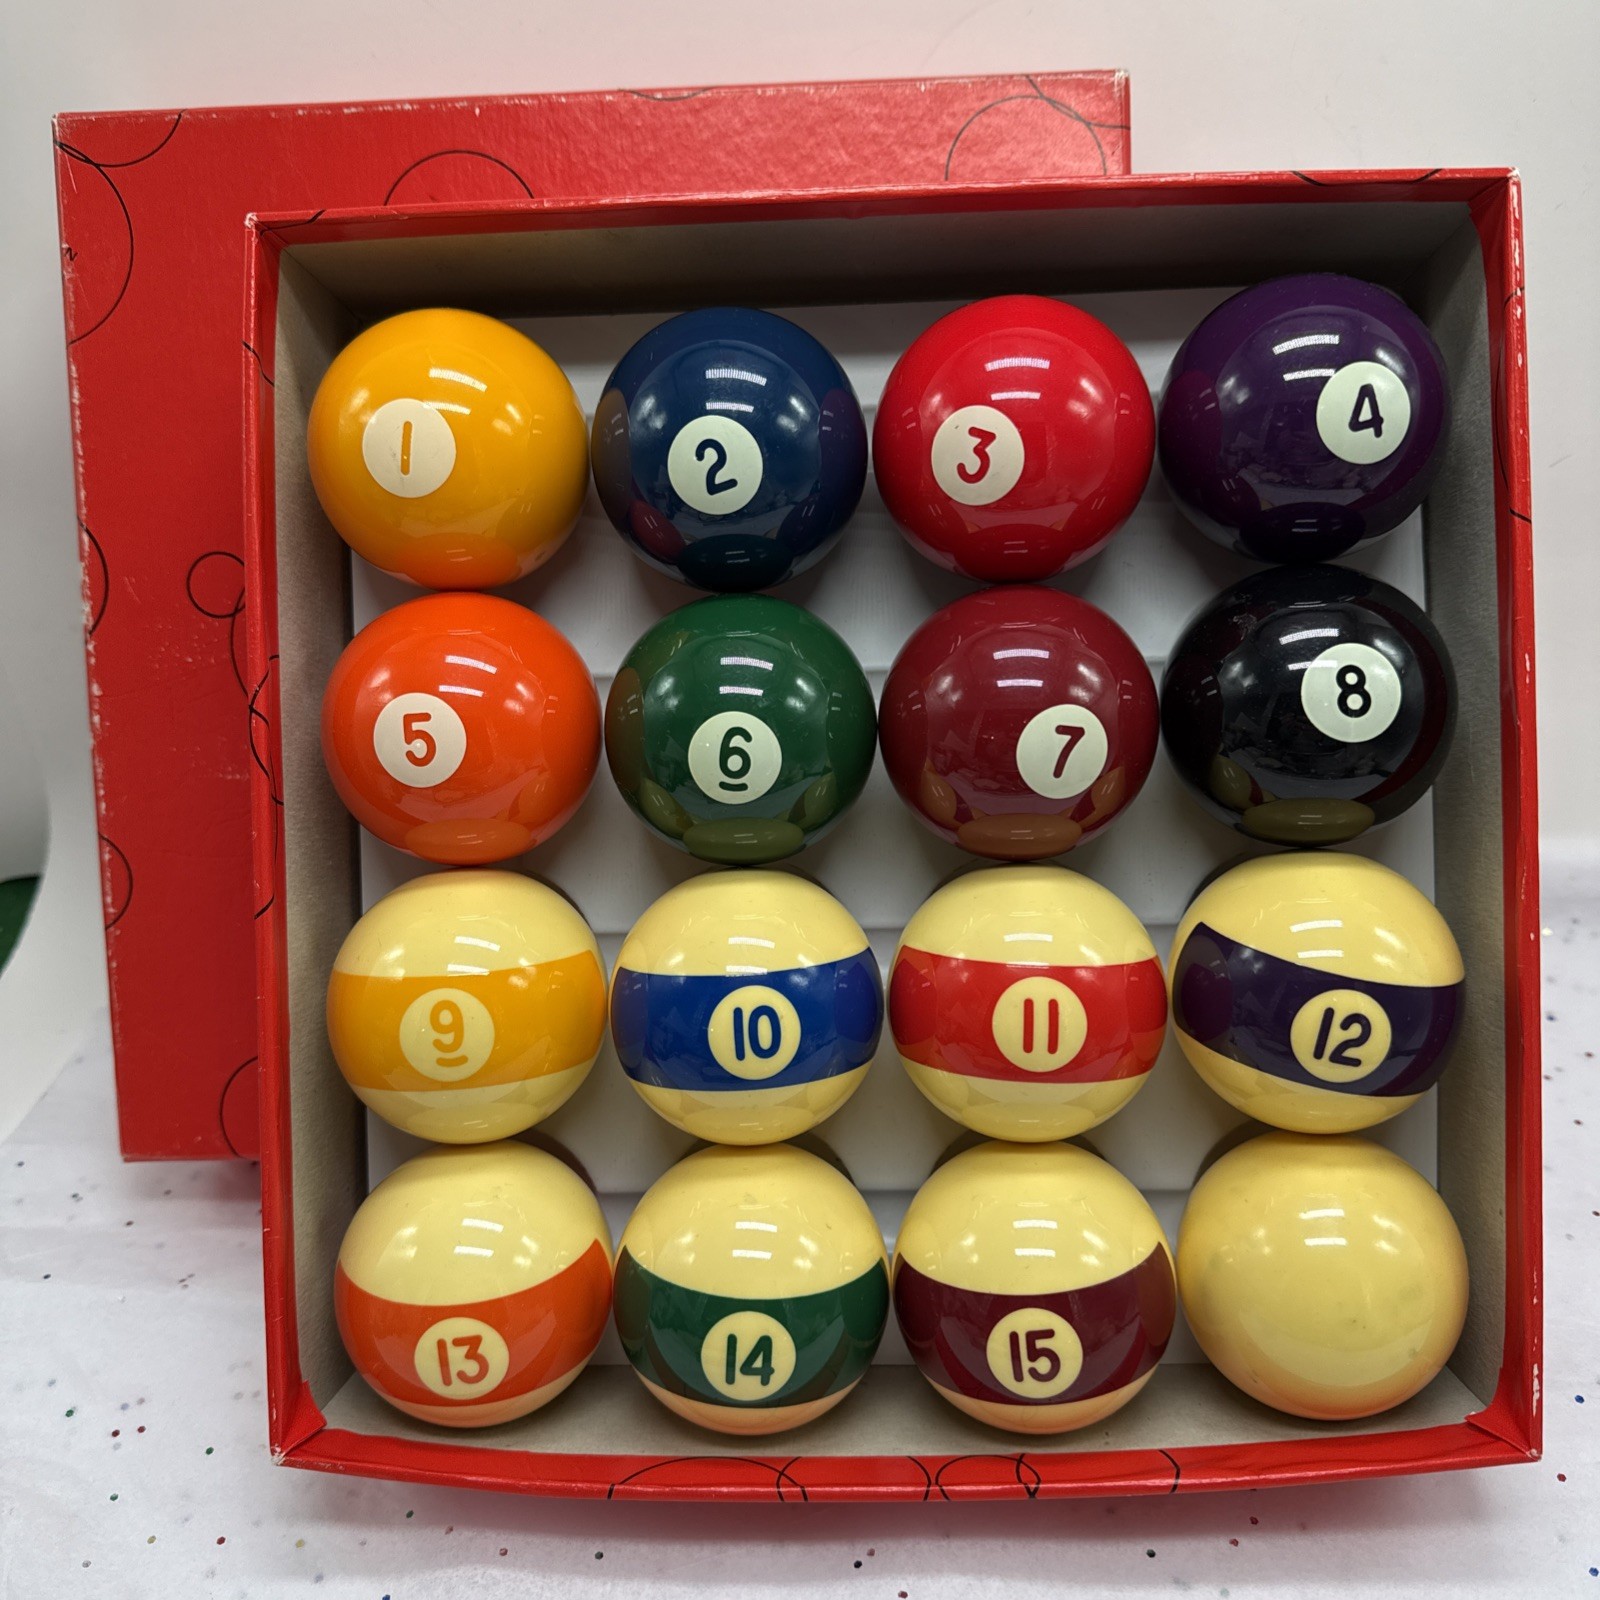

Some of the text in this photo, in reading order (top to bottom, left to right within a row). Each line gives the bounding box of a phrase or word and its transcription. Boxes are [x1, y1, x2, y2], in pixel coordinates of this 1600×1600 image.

[1348, 384, 1384, 438] 4
[401, 421, 412, 475] 1
[696, 439, 738, 495] 2
[957, 427, 996, 483] 3
[1336, 665, 1372, 718] 8
[402, 712, 436, 766] 5
[719, 726, 752, 791] 6
[1053, 725, 1085, 778] 7
[429, 999, 468, 1067] 9
[733, 1007, 781, 1061] 10
[1023, 999, 1059, 1054] 11
[1313, 1007, 1371, 1067] 12
[437, 1335, 489, 1386] 13
[725, 1333, 775, 1386] 14
[1009, 1329, 1061, 1383] 15
